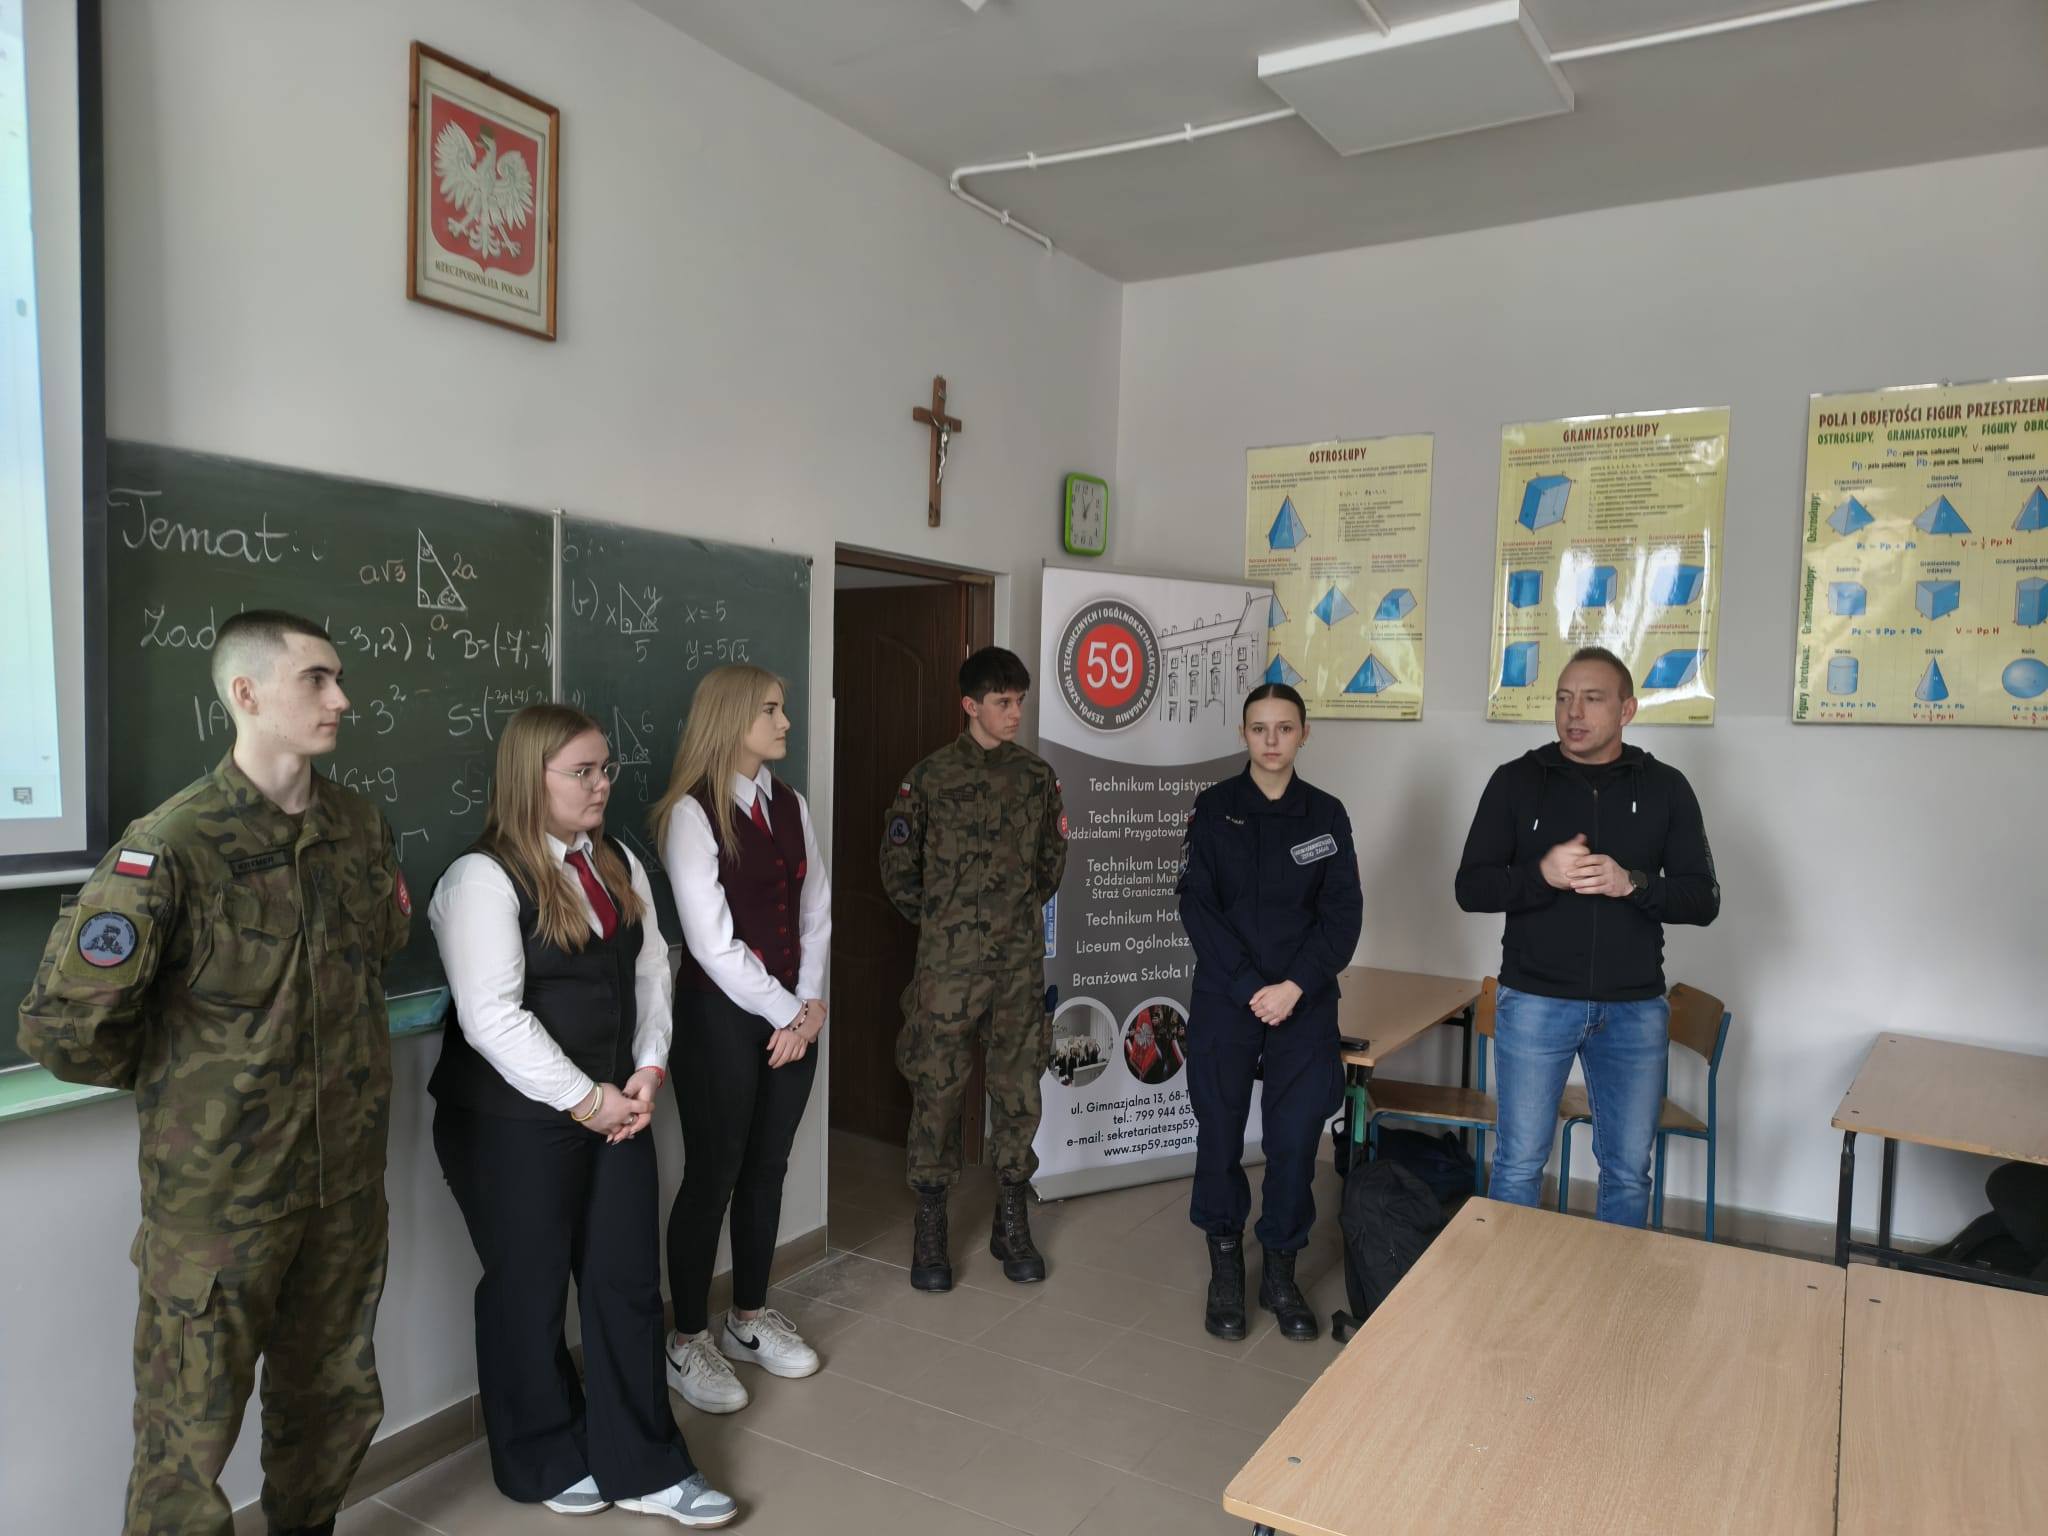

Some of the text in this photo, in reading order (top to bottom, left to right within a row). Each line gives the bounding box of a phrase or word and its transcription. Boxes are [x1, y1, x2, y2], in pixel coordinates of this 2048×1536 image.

[435, 260, 529, 299] RZECZPOSPOLITA POLSKA
[1819, 412, 1848, 428] POLA
[1852, 411, 1856, 426] I
[1861, 403, 1922, 428] OBJĘTOŚCI
[1926, 404, 1961, 421] FIGUR
[1563, 423, 1660, 443] GRANIASTOSŁUPY
[1982, 422, 2017, 436] FIGURY
[1309, 447, 1367, 464] OSTROSŁUPY
[452, 552, 478, 580] 2a
[634, 638, 651, 663] 5
[1063, 610, 1098, 673] TECHNICZNYCH
[1086, 640, 1134, 689] 59
[641, 710, 654, 734] 6
[1089, 776, 1155, 792] Technikum
[1088, 808, 1154, 824] Technikum
[1087, 856, 1153, 873] Technikum
[1085, 878, 1091, 887] z
[1093, 872, 1154, 886] Oddziałami
[1092, 886, 1175, 899] Straż Graniczna
[1085, 908, 1153, 927] Technikum
[1076, 940, 1121, 954] Liceum
[1072, 971, 1138, 987] Branżowa
[1141, 963, 1181, 981] Szkoła
[1071, 1102, 1083, 1115] ul.
[1086, 1094, 1151, 1113] Gimnazjalna
[1153, 1092, 1166, 1105] 13,
[1135, 1109, 1155, 1122] 799
[1157, 1106, 1175, 1118] 944
[1066, 1119, 1200, 1147] e-mail: sekretariat@zsp59.
